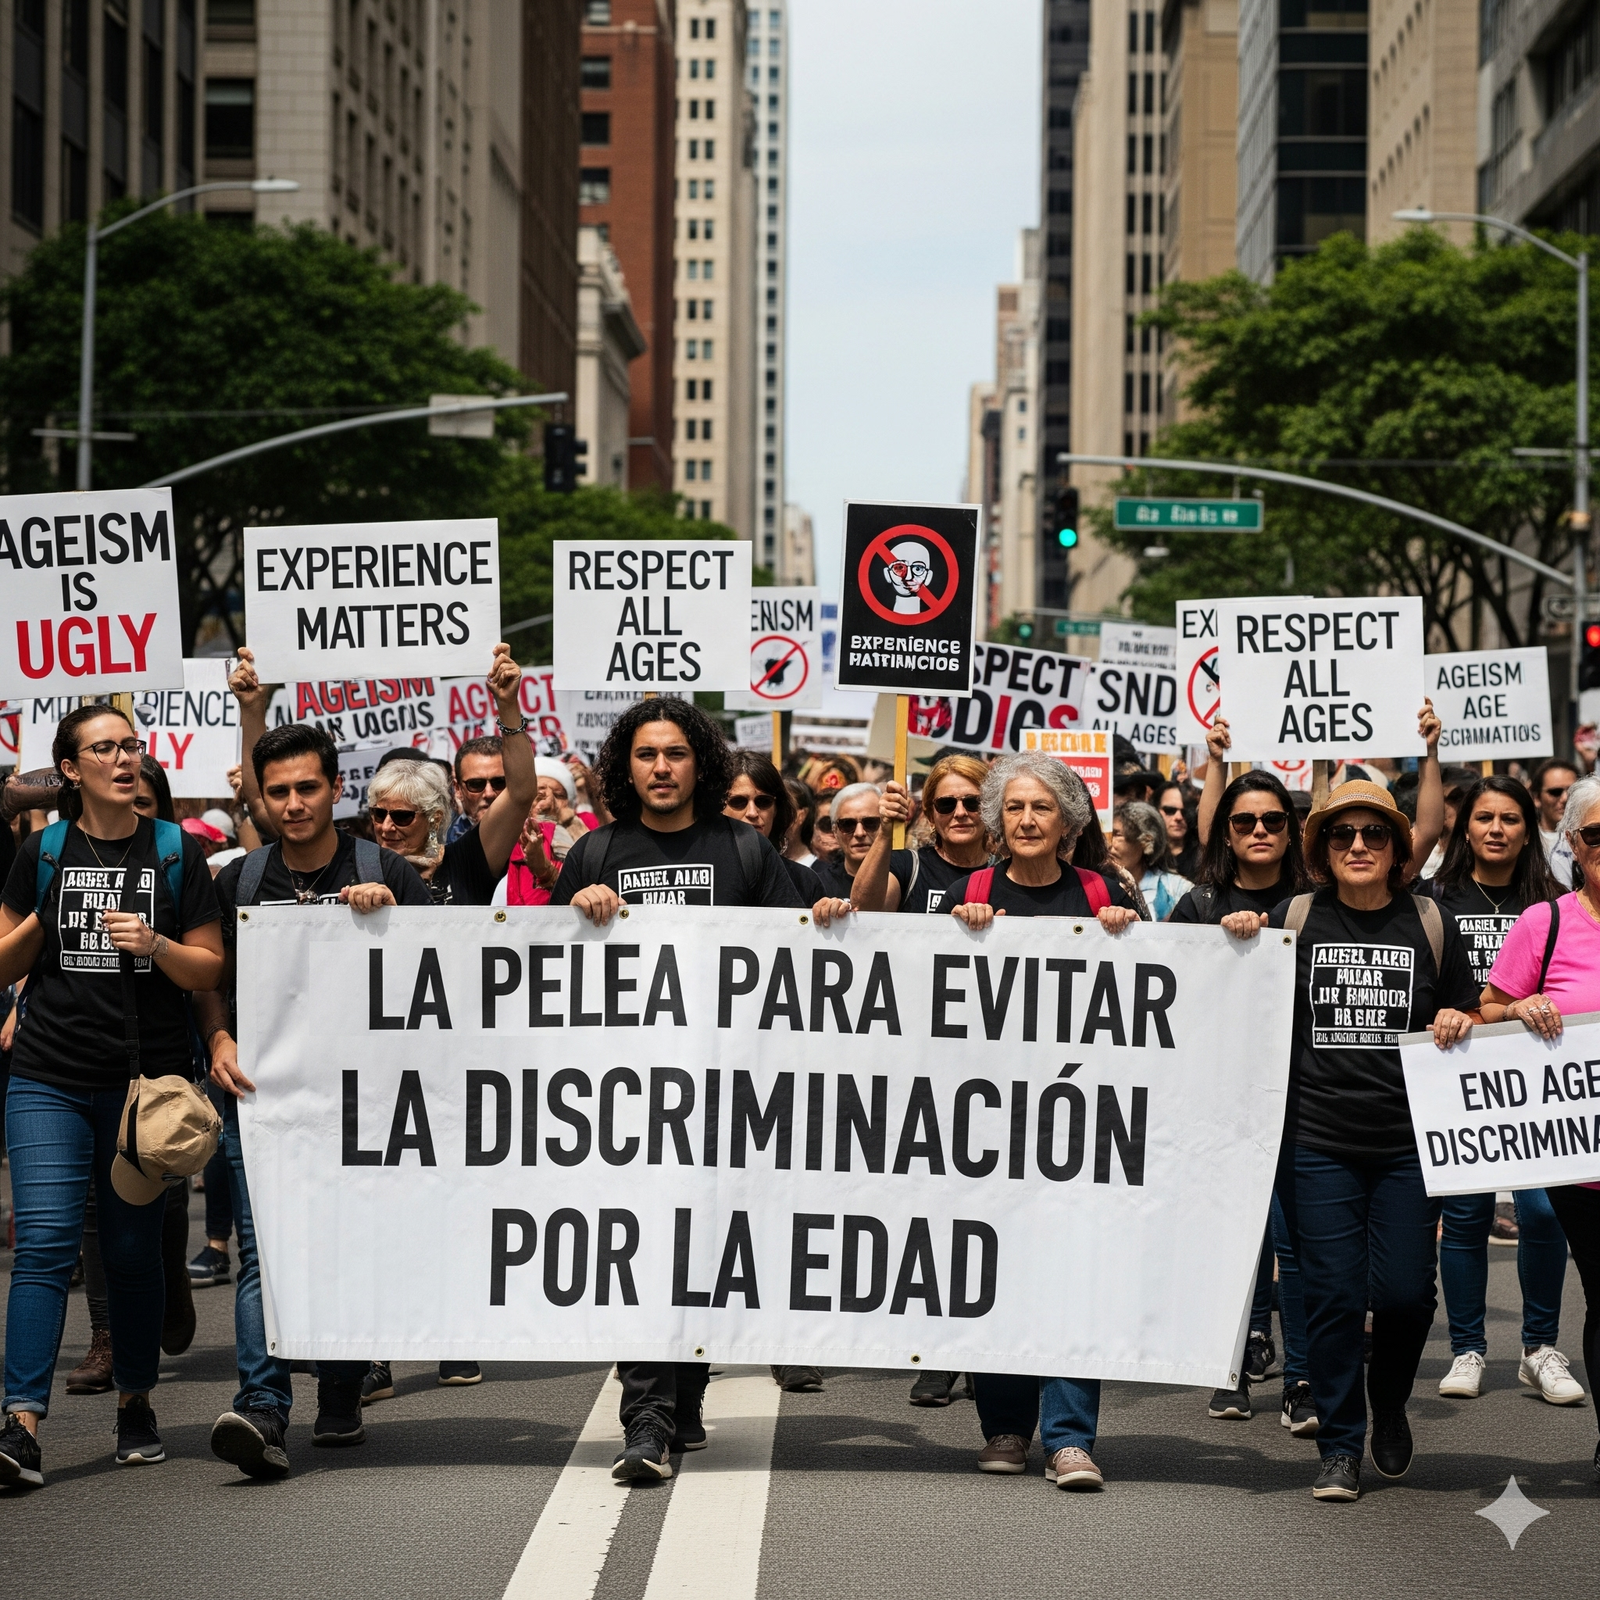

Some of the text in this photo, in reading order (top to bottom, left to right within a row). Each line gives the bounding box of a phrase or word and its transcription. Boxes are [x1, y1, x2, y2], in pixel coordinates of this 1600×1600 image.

[257, 541, 492, 591] EXPERIENCE
[570, 550, 733, 590] RESPECT
[62, 572, 97, 611] IS
[297, 602, 469, 650] MATTERS
[617, 596, 682, 635] ALL
[1183, 609, 1218, 639] EX
[1237, 612, 1399, 653] RESPECT
[17, 614, 156, 678] UGLY
[606, 642, 700, 681] AGES
[1284, 659, 1350, 698] ALL
[1437, 662, 1522, 690] AGEISM
[1279, 703, 1372, 743] AGES
[1463, 694, 1508, 719] AGE
[1131, 723, 1177, 745] AGES
[369, 945, 1176, 1048] LA PELEA PARA EVITAR
[1460, 1060, 1600, 1111] END AGE
[342, 1063, 1148, 1186] LA DISCRIMINACIÓN
[490, 1208, 998, 1318] POR LA EDAD
